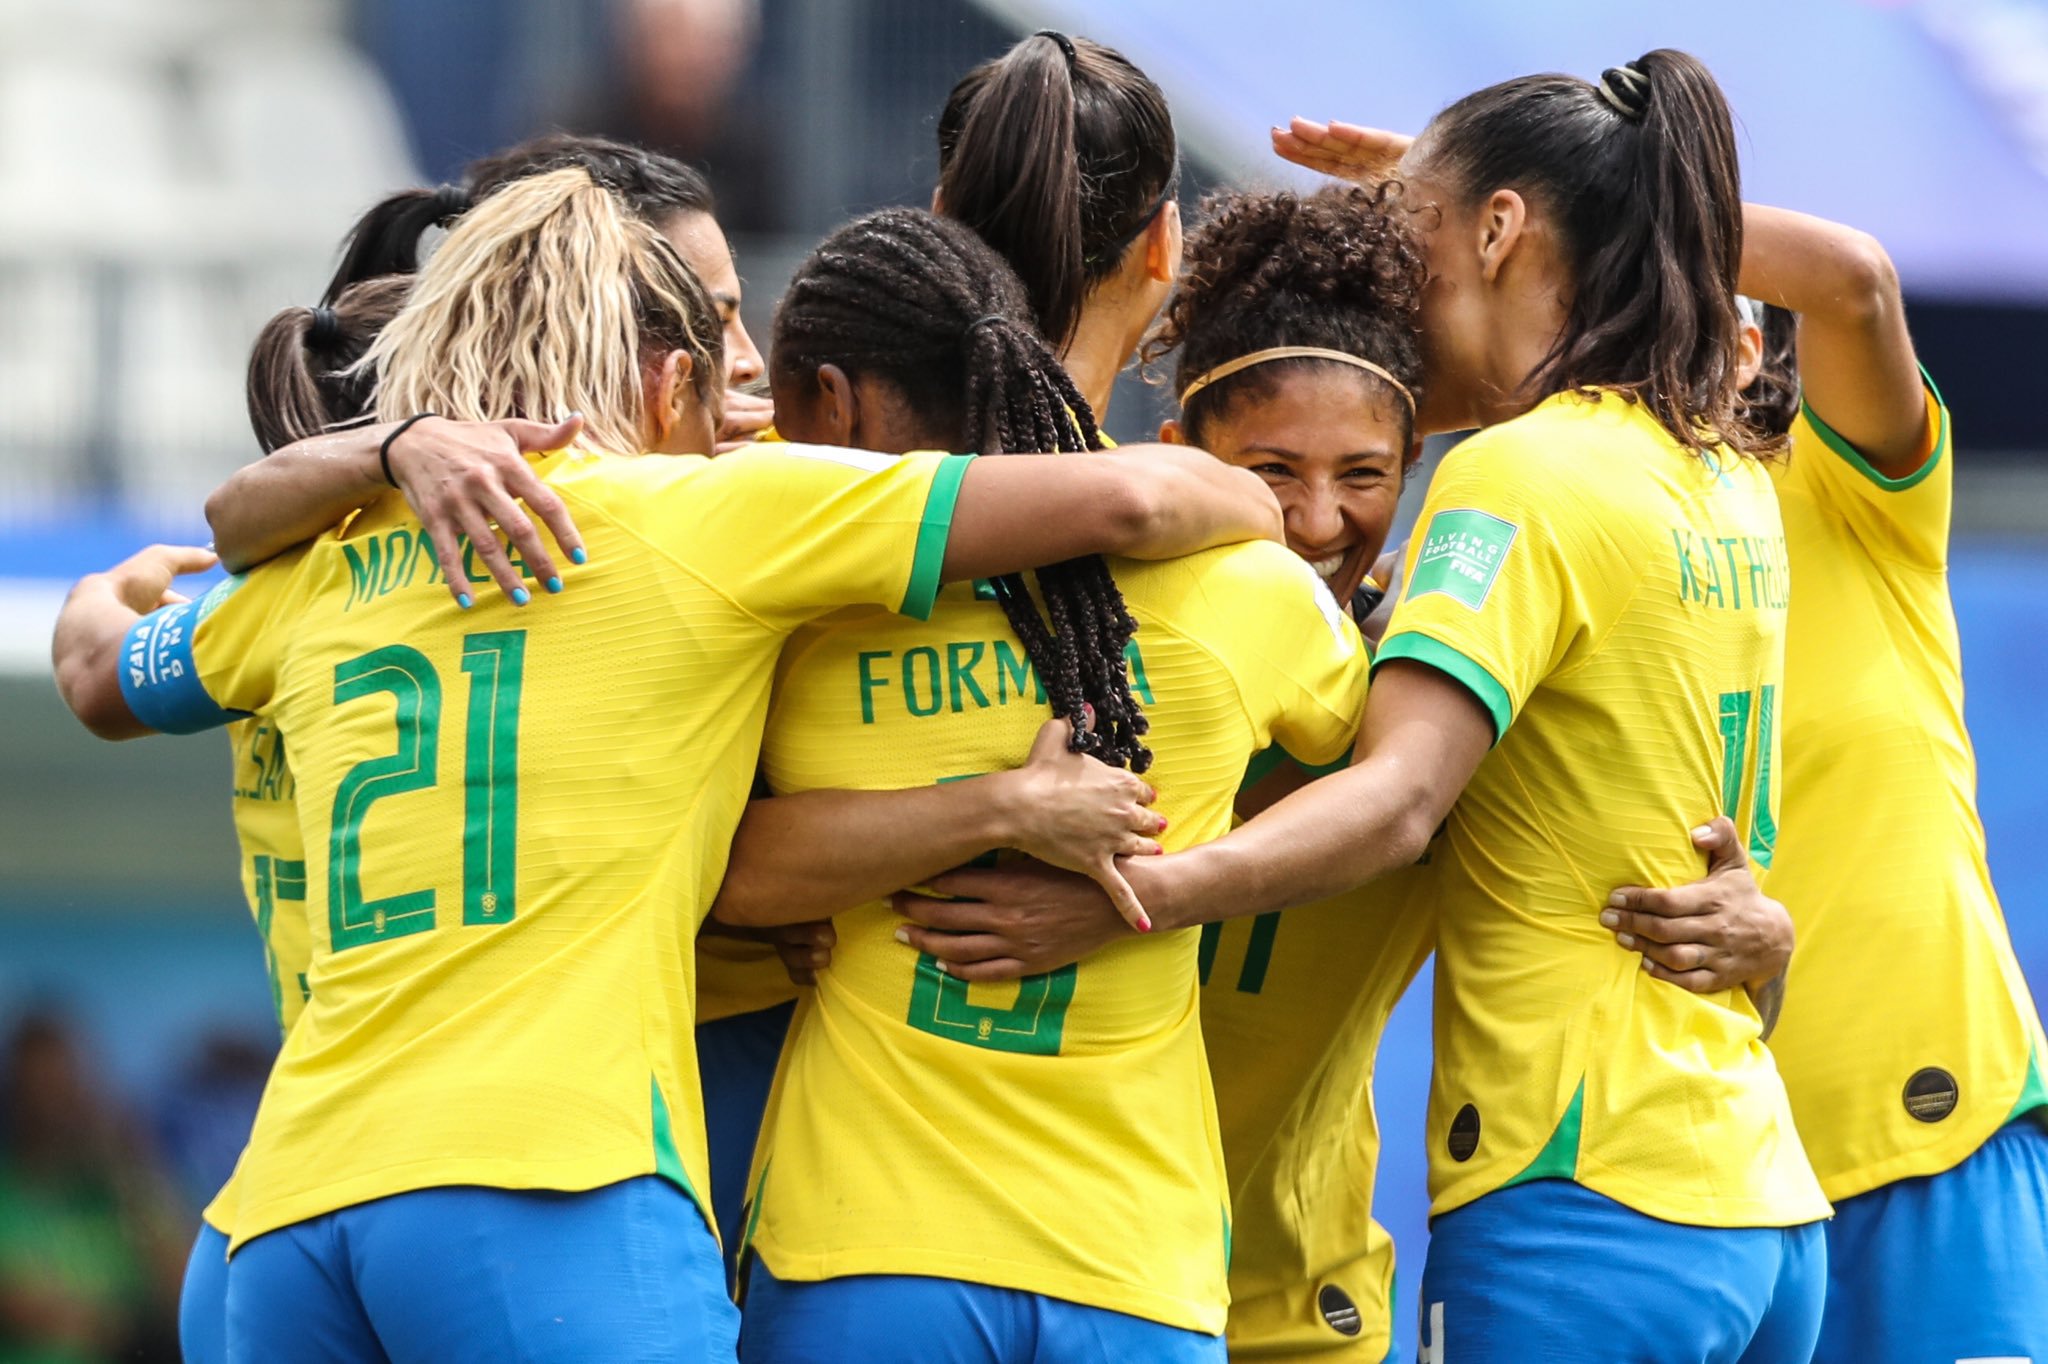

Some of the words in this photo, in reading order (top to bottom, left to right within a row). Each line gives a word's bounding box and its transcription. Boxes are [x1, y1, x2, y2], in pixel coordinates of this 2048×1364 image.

[1424, 541, 1493, 564] FOOTBALL
[1427, 531, 1499, 555] LIVING
[1450, 559, 1487, 583] FIFA
[858, 638, 1156, 724] FORMA
[328, 629, 528, 954] 21
